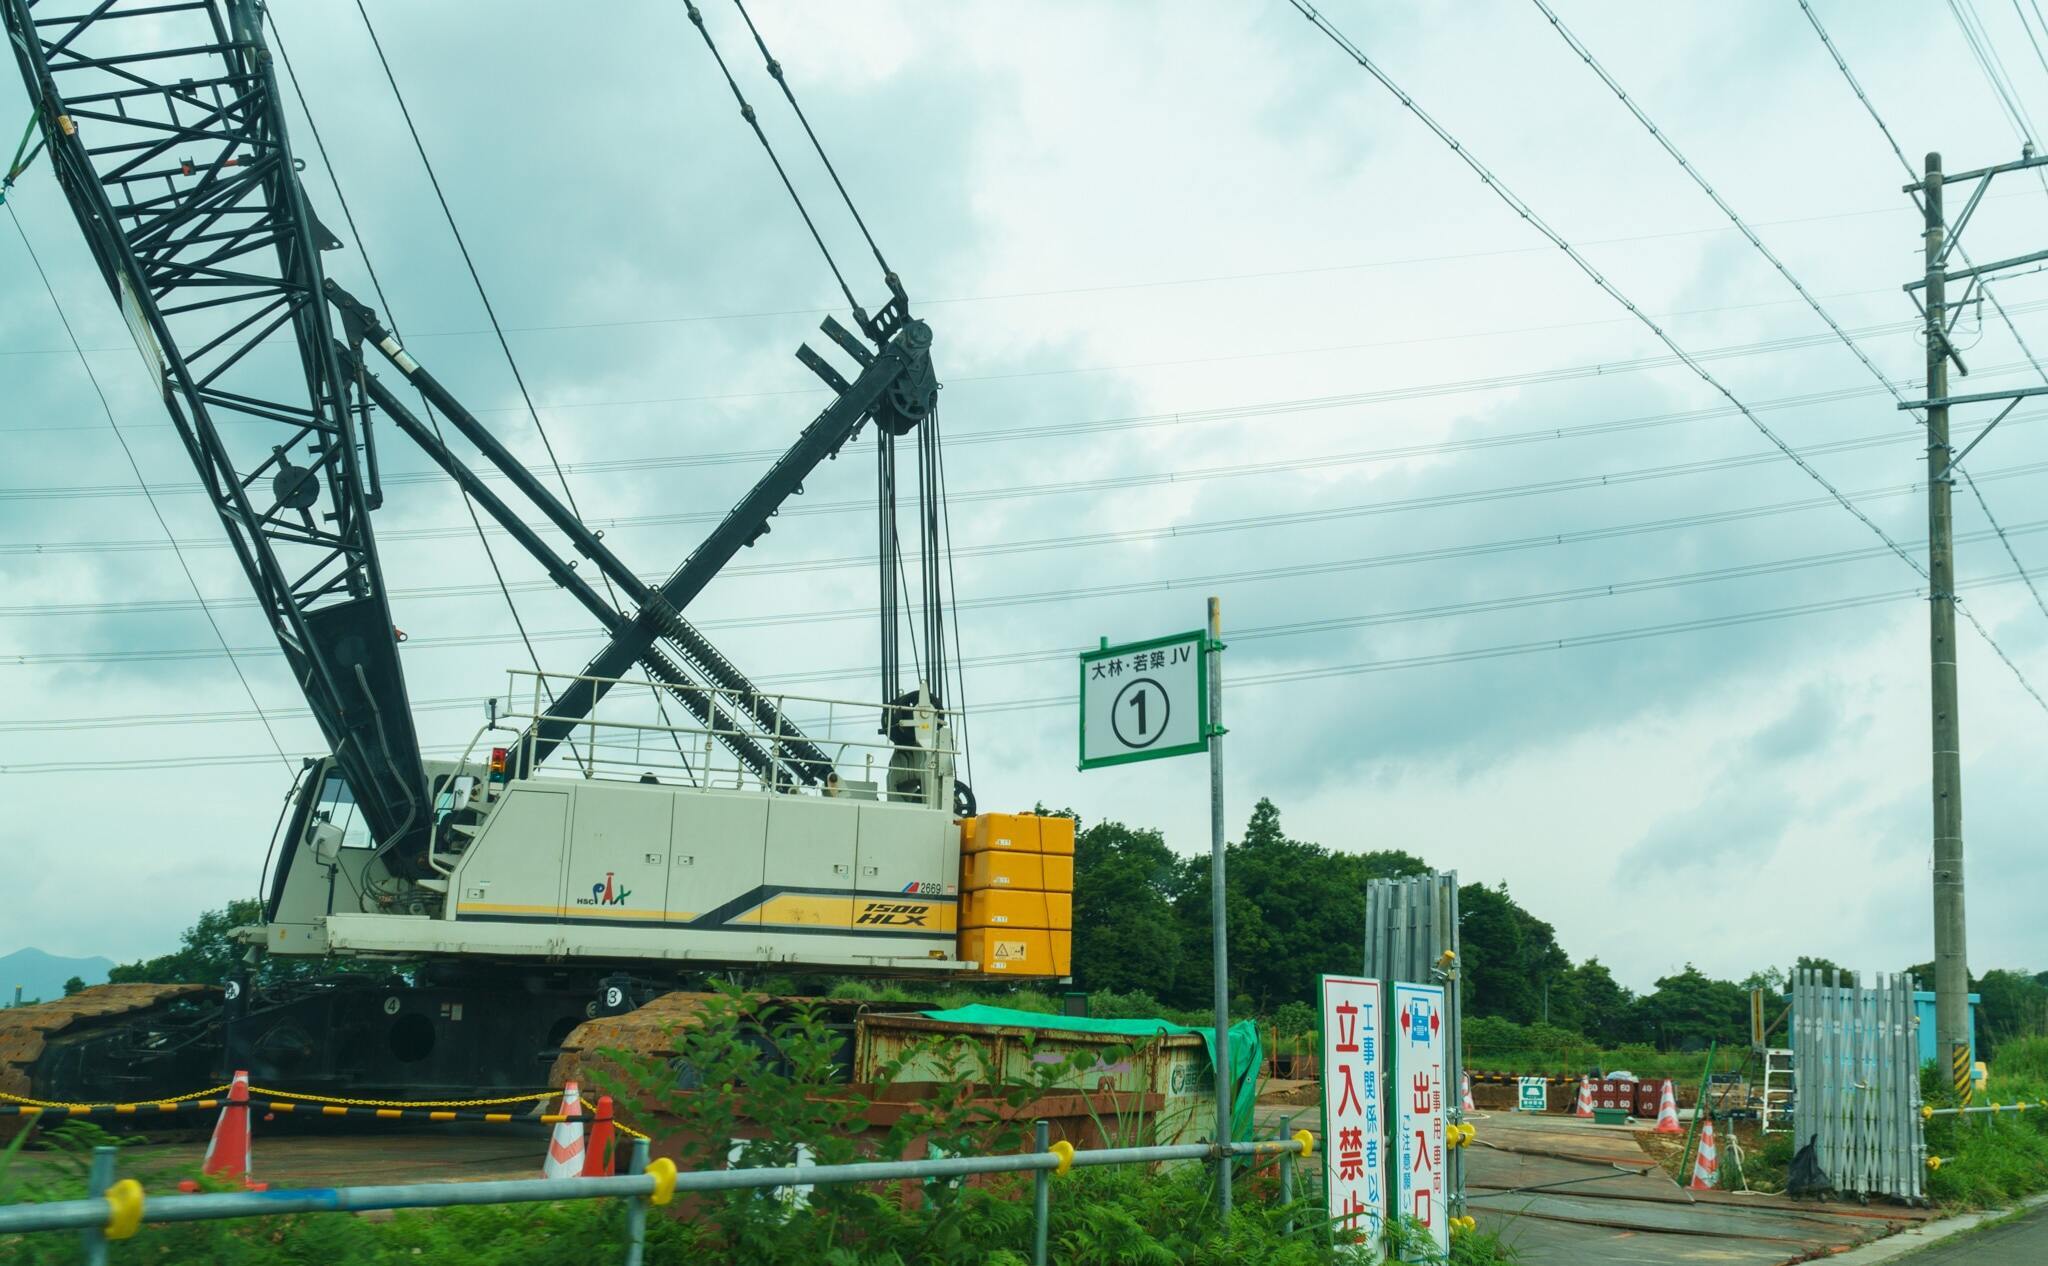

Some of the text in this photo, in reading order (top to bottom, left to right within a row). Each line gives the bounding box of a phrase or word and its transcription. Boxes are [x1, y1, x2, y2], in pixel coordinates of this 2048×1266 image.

[1092, 645, 1191, 681] 大林・若築 JV
[920, 882, 942, 894] 2669
[864, 903, 929, 915] 1500
[856, 913, 928, 927] HLX
[608, 989, 618, 1004] 3
[387, 998, 397, 1013] 4
[1603, 1084, 1614, 1092] 60
[1619, 1083, 1631, 1092] 60
[1603, 1100, 1614, 1108] 60
[1619, 1100, 1630, 1108] 60
[1335, 999, 1367, 1244] 立入禁止
[1362, 1003, 1381, 1241] 工事関係者以外
[1432, 1064, 1443, 1194] 工事用車両
[1413, 1071, 1432, 1228] 出入口
